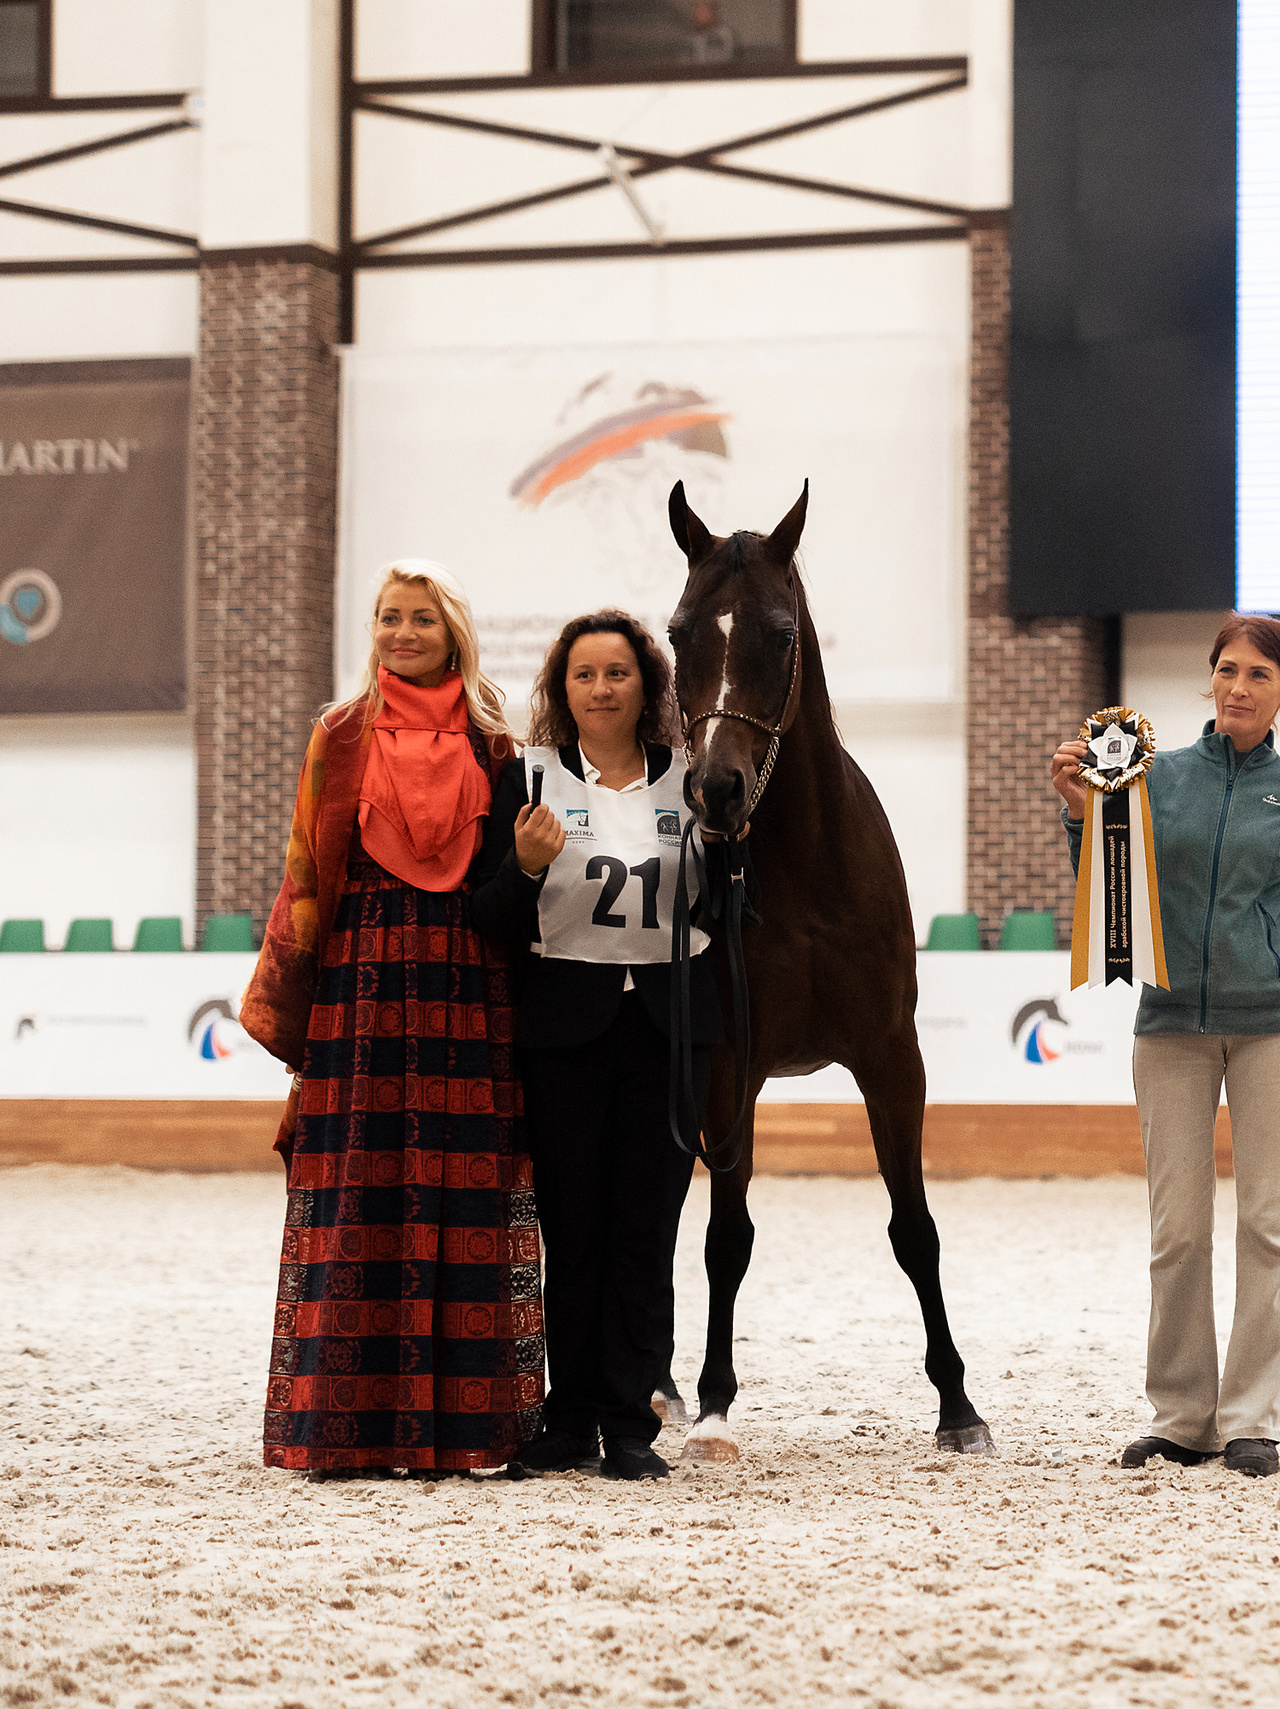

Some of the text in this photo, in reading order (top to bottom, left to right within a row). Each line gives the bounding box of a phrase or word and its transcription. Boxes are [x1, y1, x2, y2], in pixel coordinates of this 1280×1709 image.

[0, 438, 129, 475] ARTIN
[1107, 835, 1116, 866] лошадей
[586, 855, 661, 929] 21
[1109, 891, 1117, 929] Чемпионат
[1119, 840, 1129, 949] арабской чистокровной породы
[1109, 929, 1117, 949] XVIII
